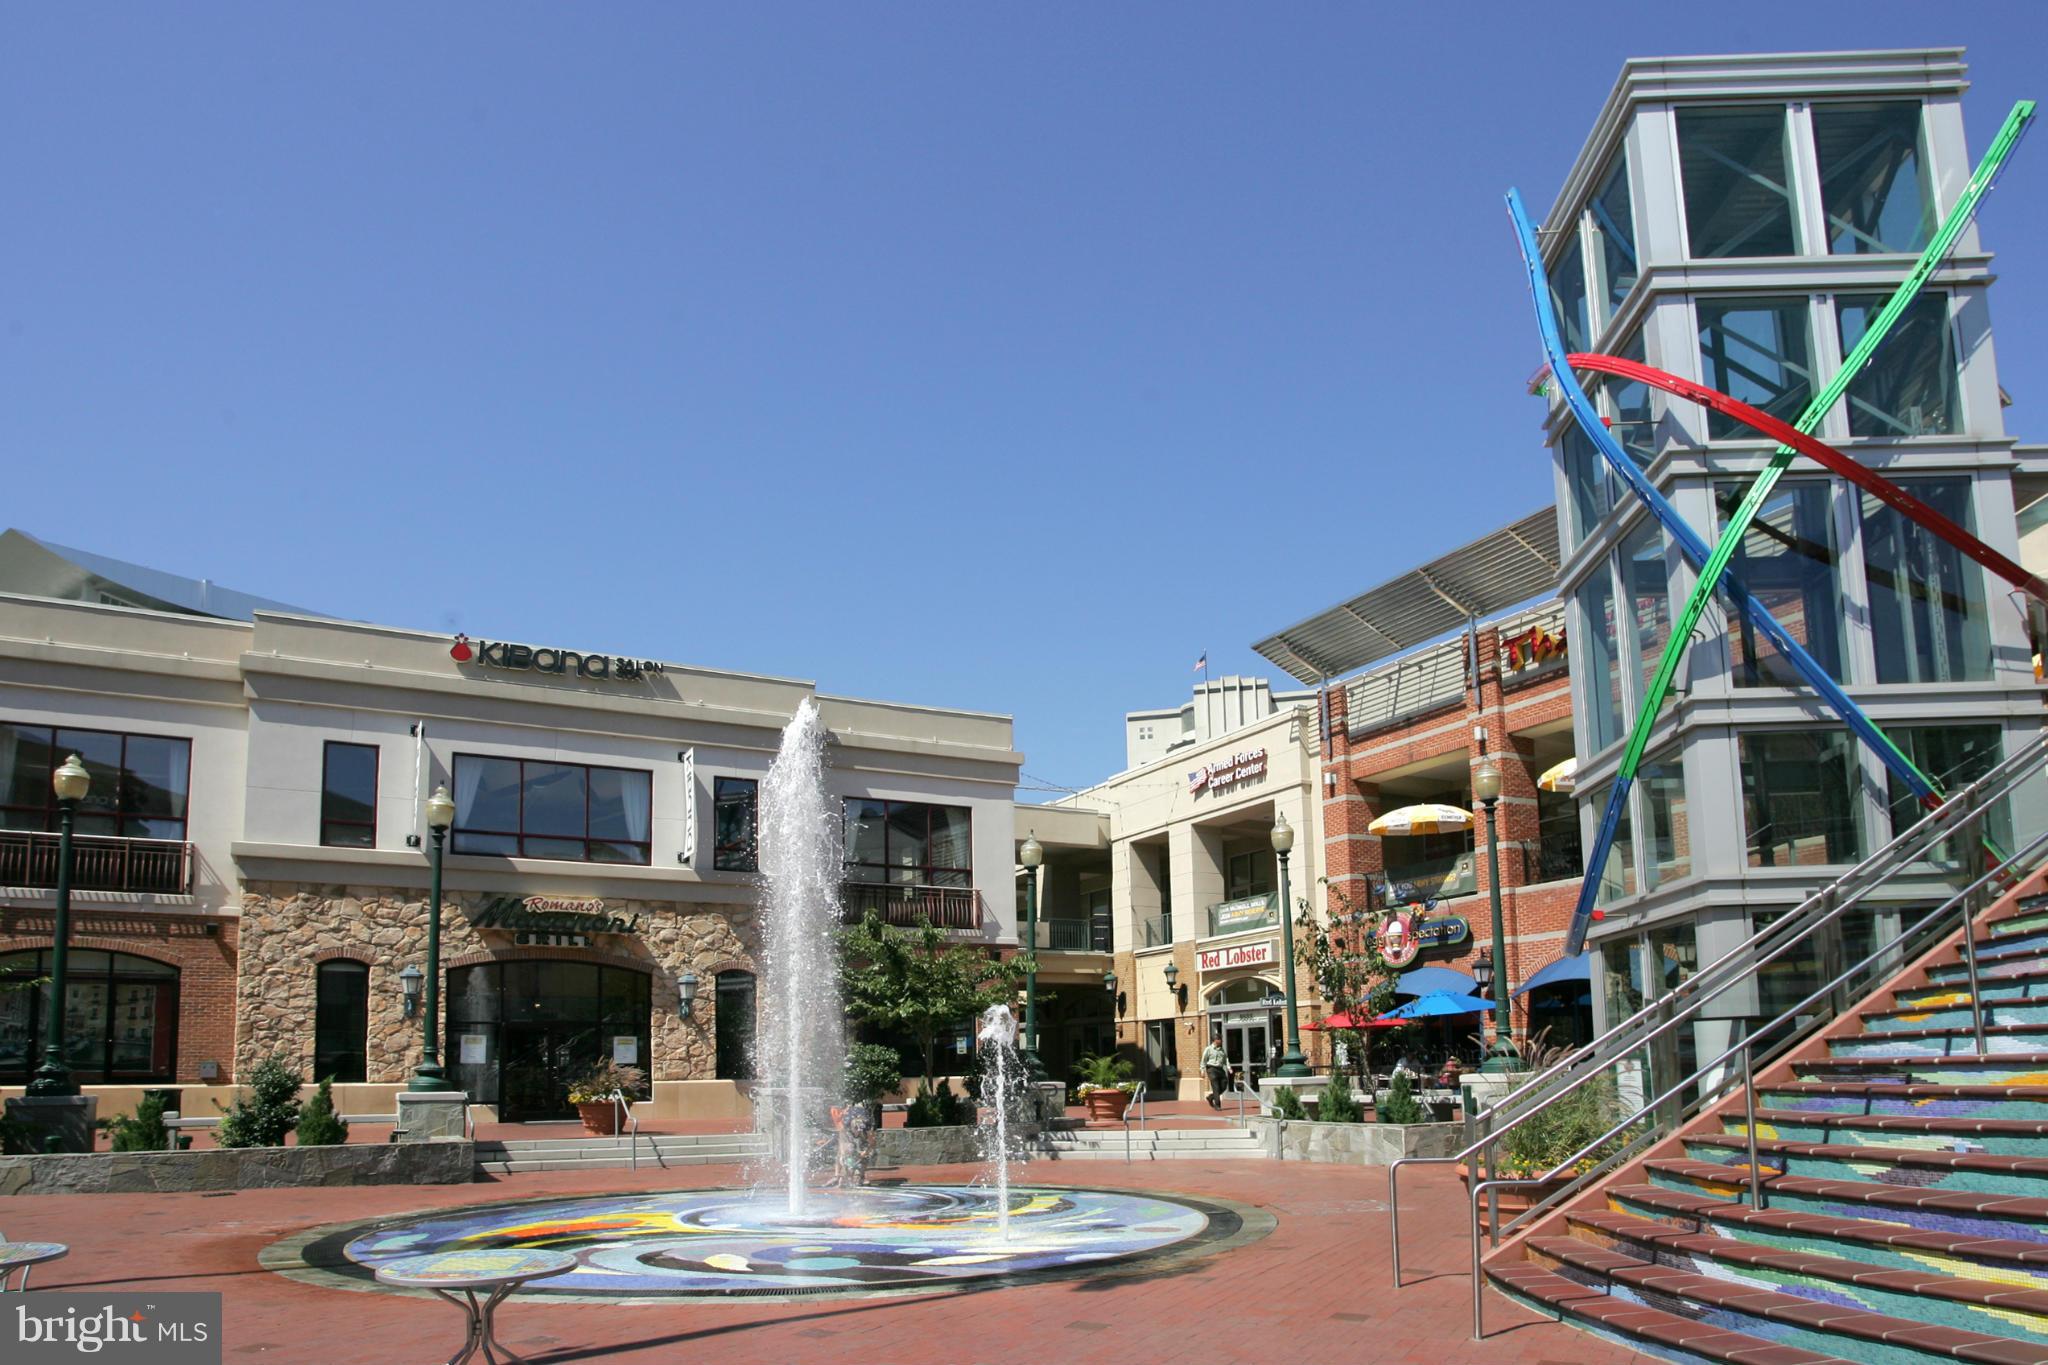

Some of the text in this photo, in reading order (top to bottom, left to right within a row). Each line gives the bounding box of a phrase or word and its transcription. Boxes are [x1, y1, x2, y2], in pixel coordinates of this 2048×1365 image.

[1208, 747, 1265, 774] Armed Forces
[1208, 761, 1265, 789] Career Center
[523, 896, 602, 914] Romano's
[1201, 945, 1267, 969] Red Lobster
